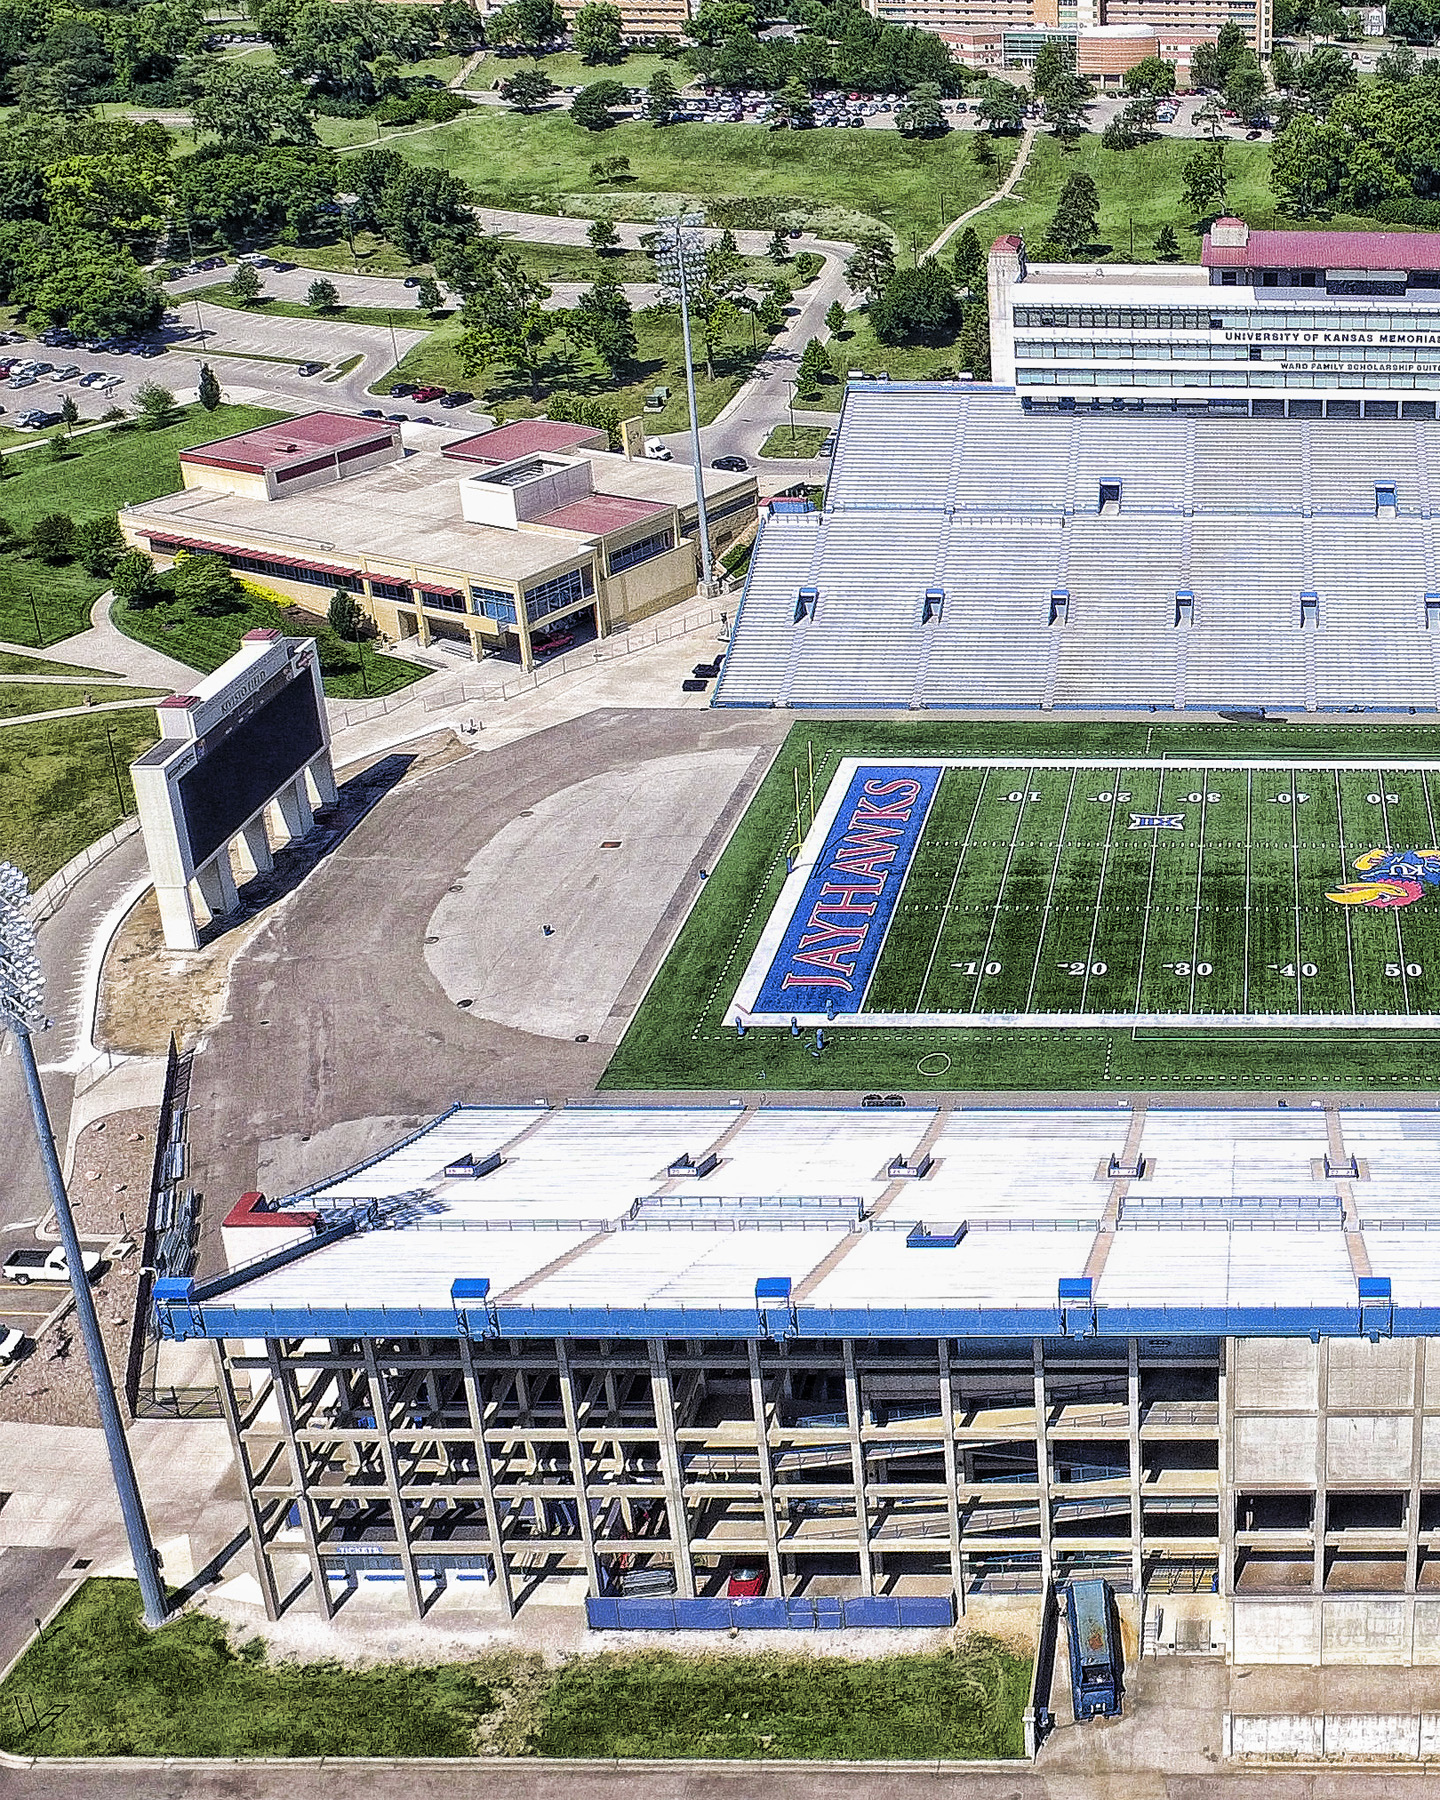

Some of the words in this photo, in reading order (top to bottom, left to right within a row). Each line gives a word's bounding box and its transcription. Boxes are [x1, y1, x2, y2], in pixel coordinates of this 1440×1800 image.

[1225, 332, 1300, 341] UNIVERSITY
[1303, 333, 1319, 341] OF
[1324, 333, 1374, 342] KANSAS
[1311, 363, 1344, 371] FAMILY
[1347, 364, 1414, 372] SCHOLARSHIP
[1004, 791, 1042, 801] 10
[1098, 791, 1132, 802] 20
[1188, 792, 1222, 803] 30
[1278, 793, 1310, 803] 40
[1366, 793, 1399, 804] 50
[1389, 862, 1426, 880] KU
[782, 779, 922, 992] JAYHAWKS
[960, 962, 1002, 976] 10
[1065, 962, 1108, 976] 20
[1172, 963, 1213, 976] 30
[1275, 963, 1318, 977] 40
[1385, 963, 1422, 977] 50
[339, 1545, 382, 1554] TICKETS
